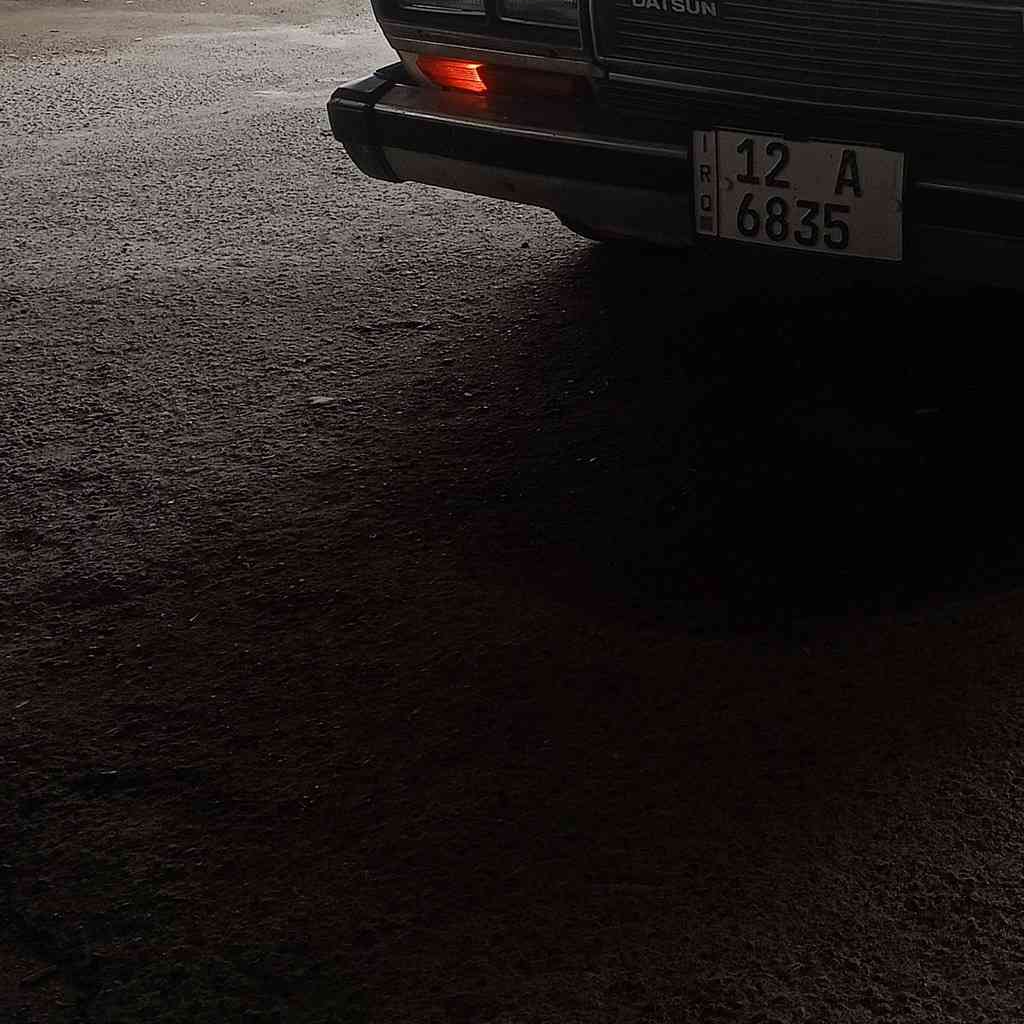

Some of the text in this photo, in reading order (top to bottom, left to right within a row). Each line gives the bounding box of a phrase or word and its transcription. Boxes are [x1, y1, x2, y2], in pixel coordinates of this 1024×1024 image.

[736, 137, 864, 197] 12 A
[736, 192, 850, 250] 6835
